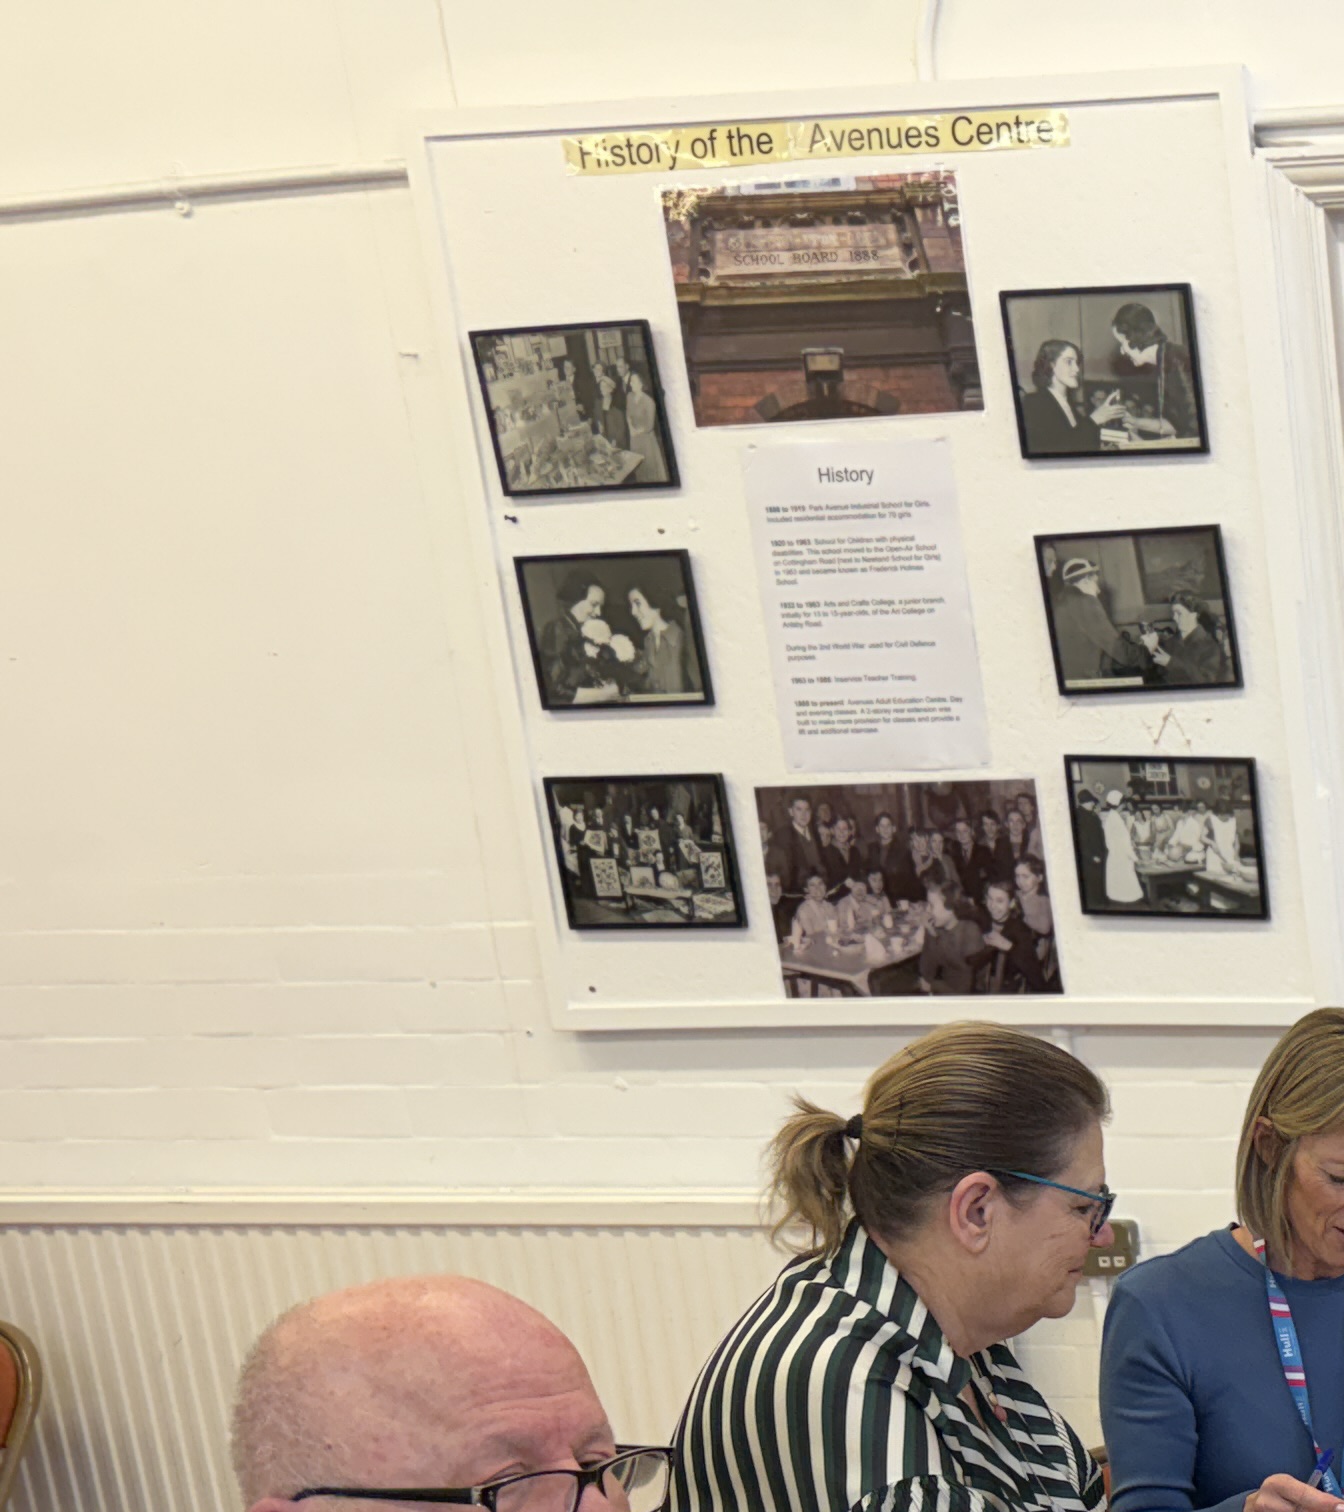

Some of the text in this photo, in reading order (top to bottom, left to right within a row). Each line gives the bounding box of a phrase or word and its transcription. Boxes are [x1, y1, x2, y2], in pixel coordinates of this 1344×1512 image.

[579, 114, 1055, 171] History of the Avenues Centre
[734, 249, 880, 267] SCHOOL BOARD 1888
[817, 466, 875, 486] History
[1280, 1332, 1294, 1358] Hull
